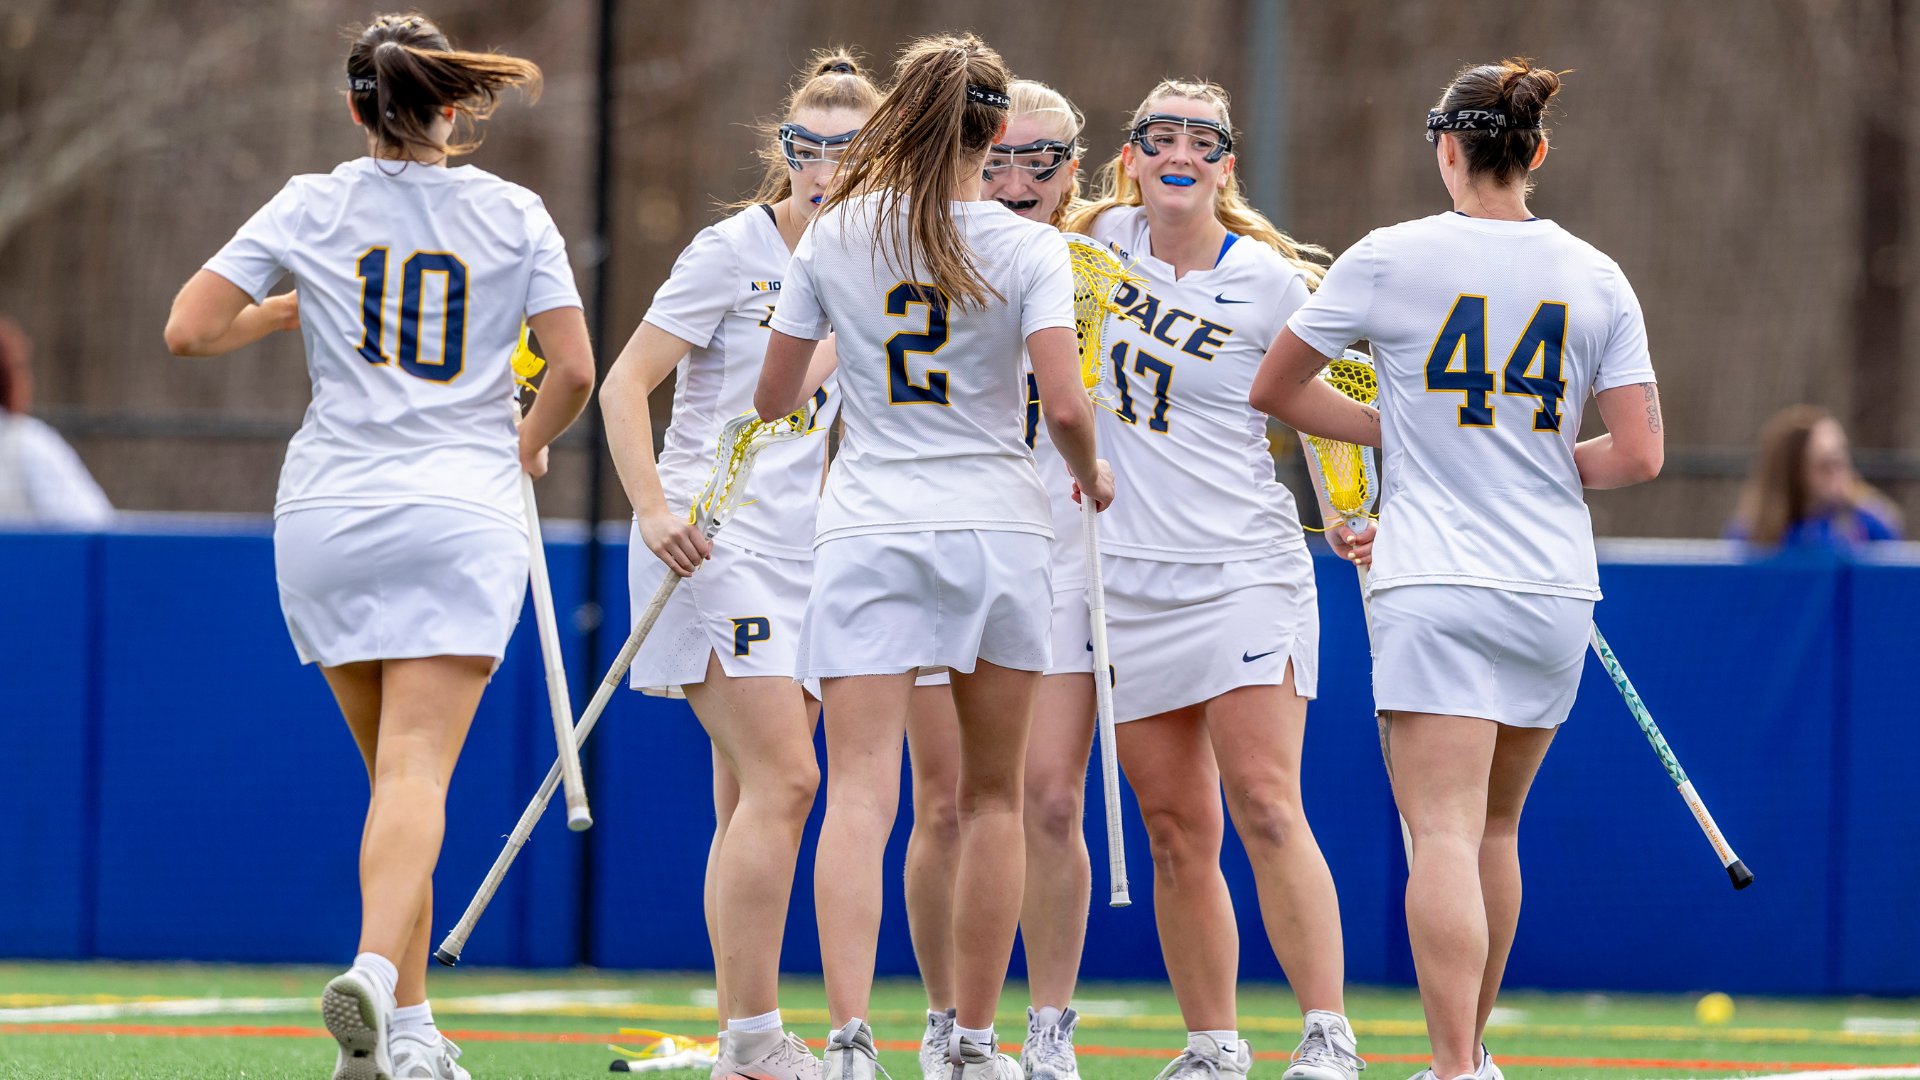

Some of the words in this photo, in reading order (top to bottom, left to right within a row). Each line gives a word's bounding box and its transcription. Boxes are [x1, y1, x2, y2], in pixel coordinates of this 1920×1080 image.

[1457, 109, 1495, 120] STX
[356, 246, 469, 385] 10
[751, 281, 782, 292] NE10
[884, 280, 952, 406] 2
[1114, 281, 1234, 362] PACE
[1110, 339, 1175, 434] 17
[1424, 293, 1568, 434] 44
[726, 616, 771, 657] P
[1692, 802, 1710, 829] MESSAGE
[1709, 829, 1728, 860] MORGAN'S
